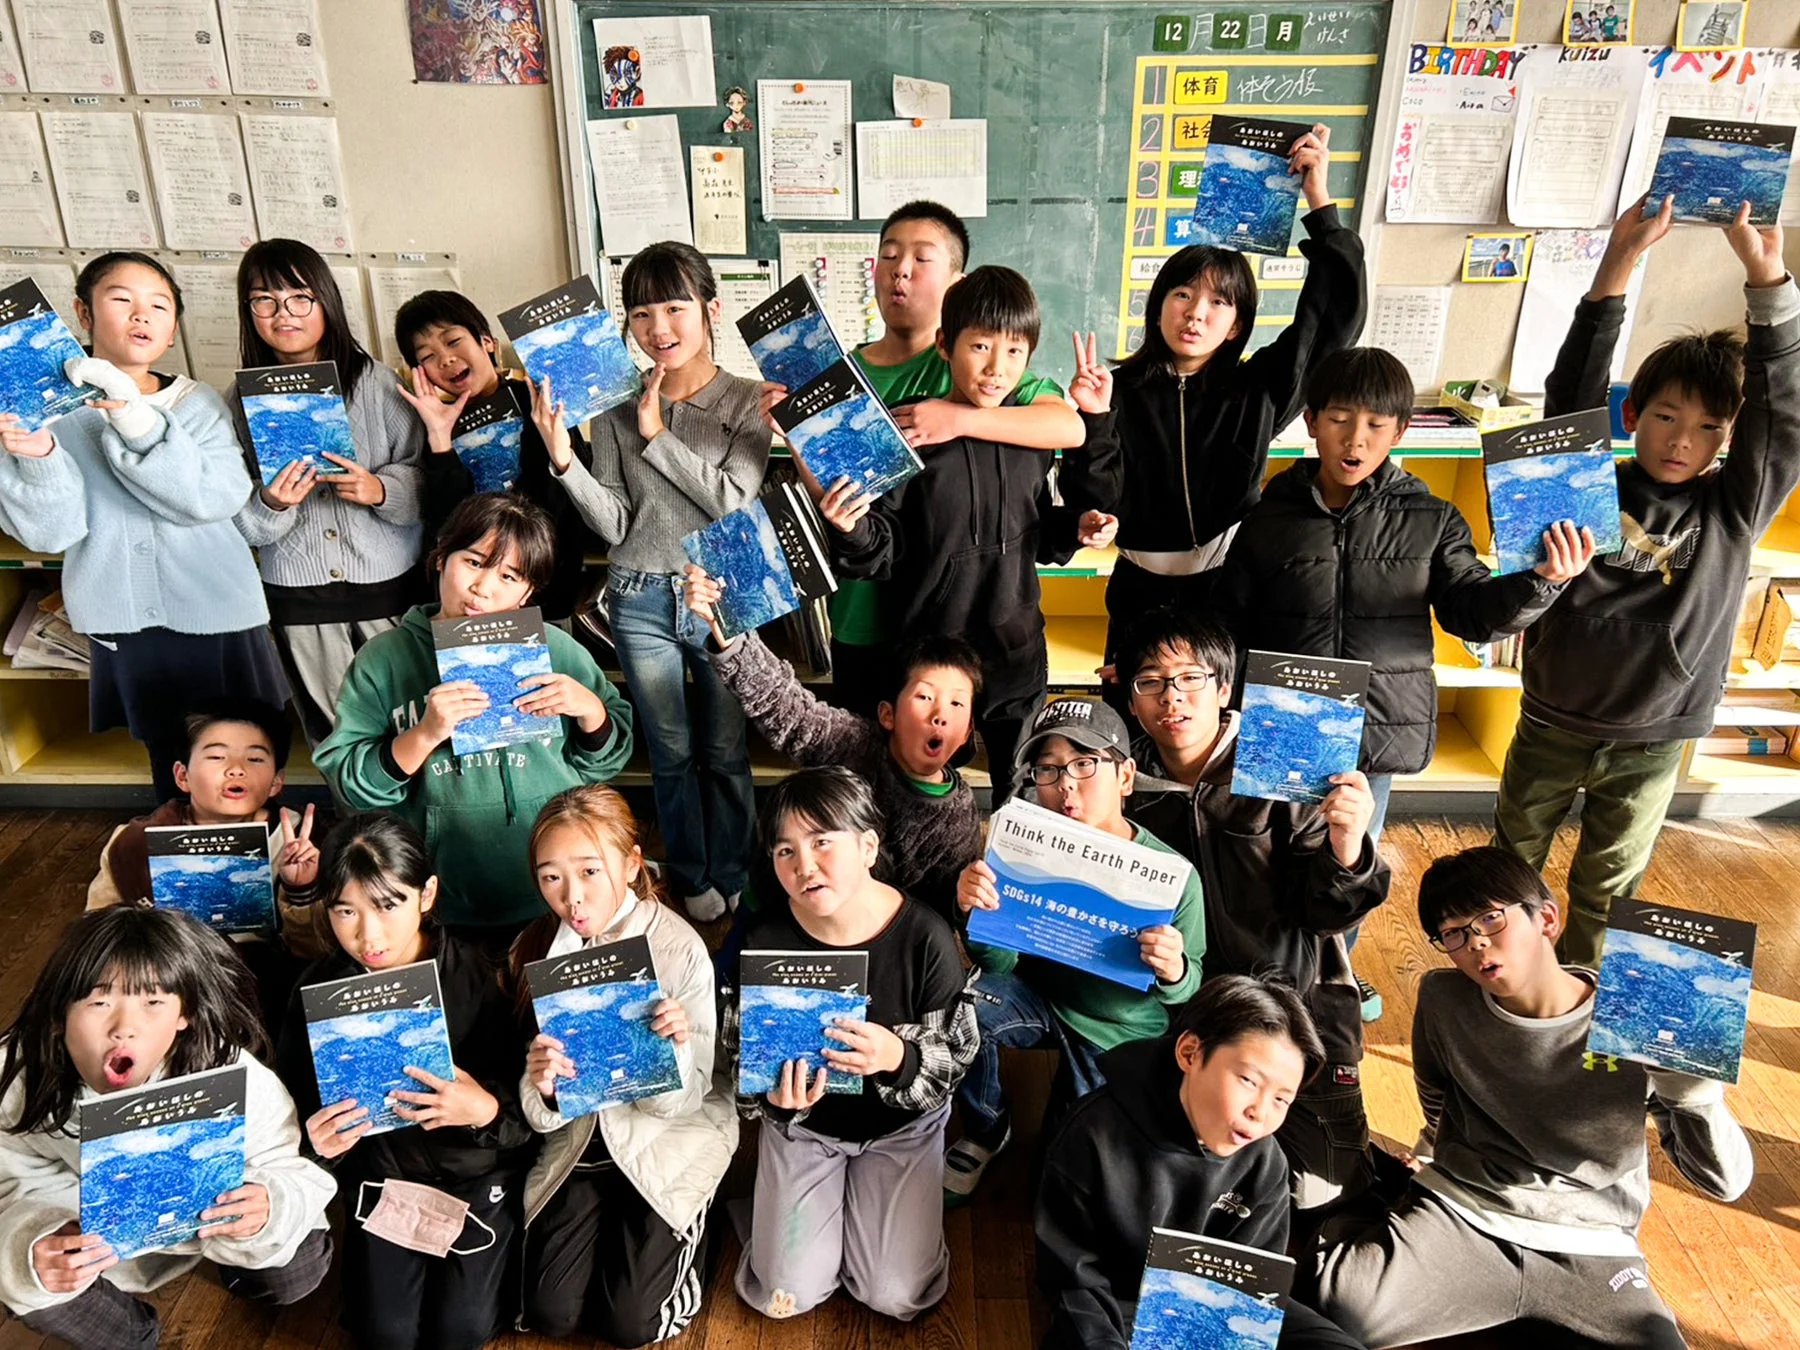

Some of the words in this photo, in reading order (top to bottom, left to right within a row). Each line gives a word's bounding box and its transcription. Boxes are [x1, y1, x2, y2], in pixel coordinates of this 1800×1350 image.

[1164, 23, 1183, 41] 12
[1220, 20, 1241, 39] 22
[1276, 21, 1293, 42] 月
[1316, 28, 1350, 45] けんさ
[1409, 44, 1527, 81] BIRTHDAY
[1649, 46, 1755, 85] イベント
[1183, 77, 1219, 95] 体育
[1140, 117, 1161, 151] 2
[1182, 121, 1212, 140] 社会
[1136, 160, 1159, 198] 3
[1178, 169, 1202, 189] 理
[1132, 206, 1156, 247] 4
[1128, 289, 1147, 318] 5
[431, 751, 527, 777] CATIVTE
[1005, 819, 1045, 844] Think
[1050, 835, 1075, 854] the
[1081, 845, 1124, 869] Earth
[1129, 860, 1177, 886] Paper
[1002, 884, 1043, 908] SDGs14
[1045, 899, 1138, 939] 海の豊かさを守ろう
